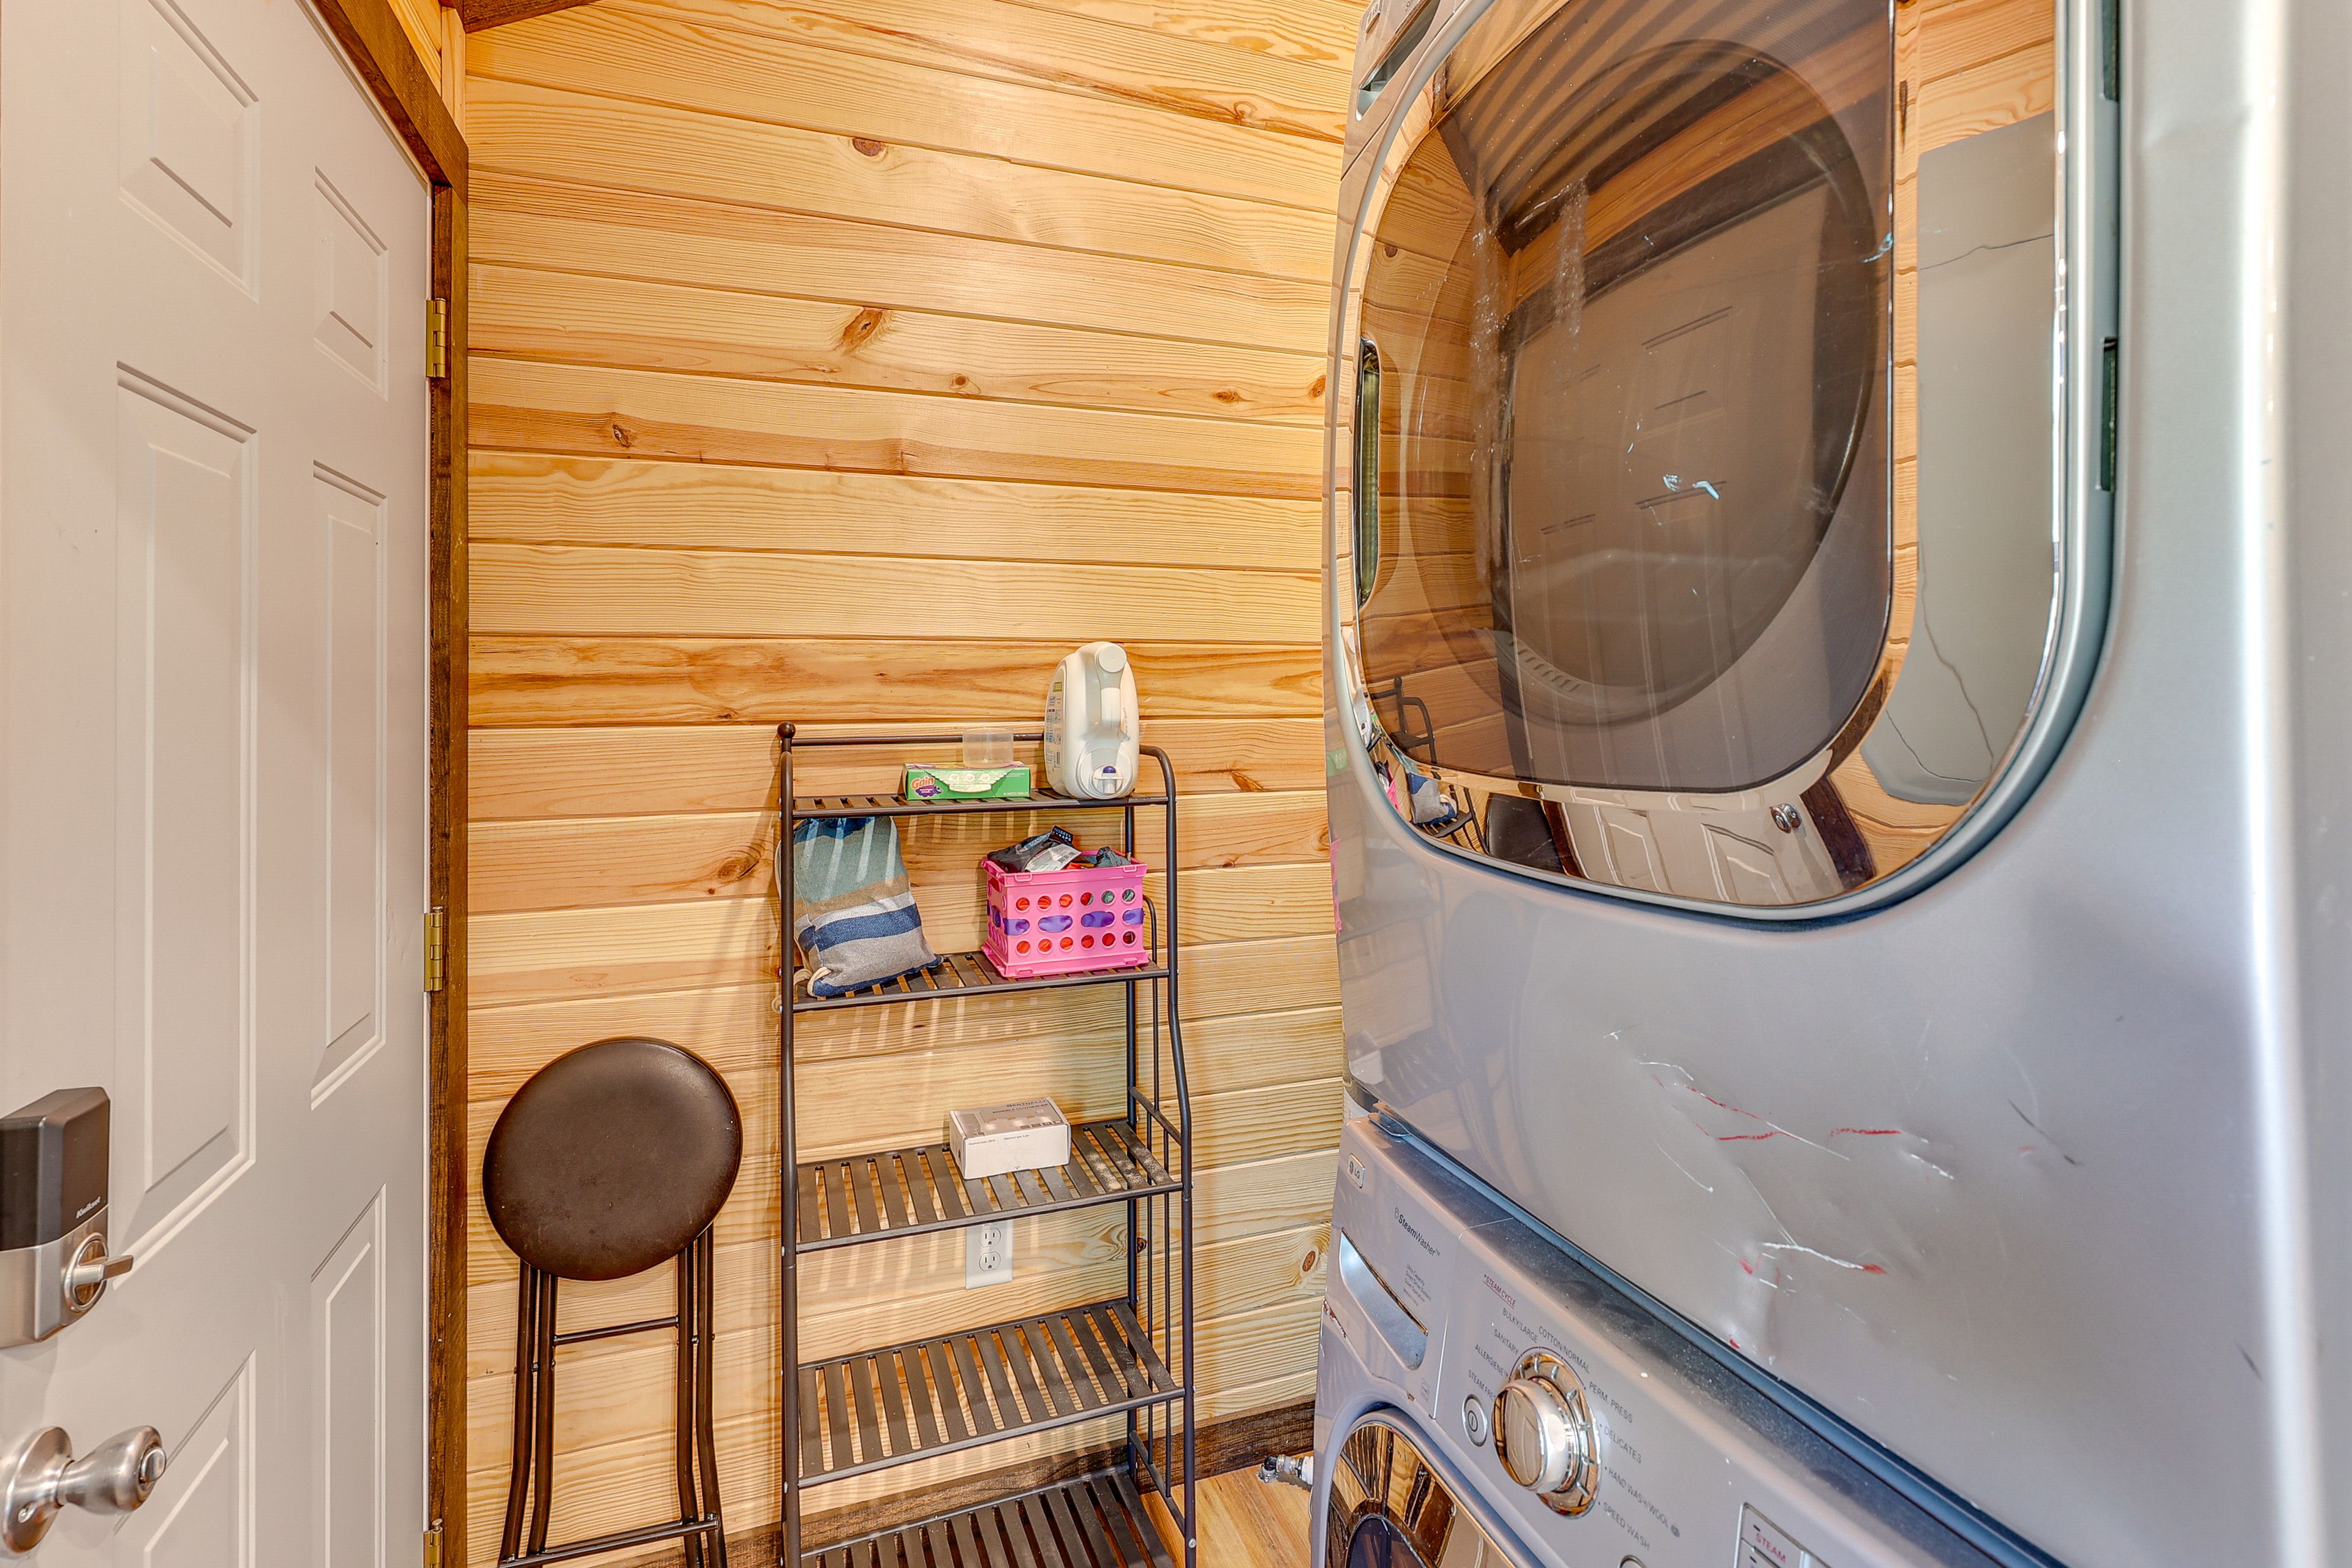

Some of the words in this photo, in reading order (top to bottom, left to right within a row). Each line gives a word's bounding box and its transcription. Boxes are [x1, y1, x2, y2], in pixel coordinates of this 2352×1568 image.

[911, 776, 935, 790] Gain
[1354, 1167, 1360, 1179] LG
[76, 1196, 100, 1219] Kwikset
[1486, 1276, 1501, 1294] STEAM
[1501, 1287, 1517, 1307] CYCLE
[1502, 1308, 1538, 1344] BULKY/LARGE
[1494, 1329, 1519, 1355] SANITARY
[1539, 1326, 1590, 1374] COTTON/NORMAL
[1468, 1370, 1484, 1390] STEAM
[1589, 1381, 1609, 1405] PERM.
[1611, 1399, 1634, 1423] PRESS
[1604, 1427, 1642, 1464] DELICATES
[1609, 1468, 1626, 1488] HAND
[1603, 1502, 1626, 1528] SPEED
[1627, 1524, 1650, 1551] WASH
[1755, 1532, 1787, 1563] STEAM
